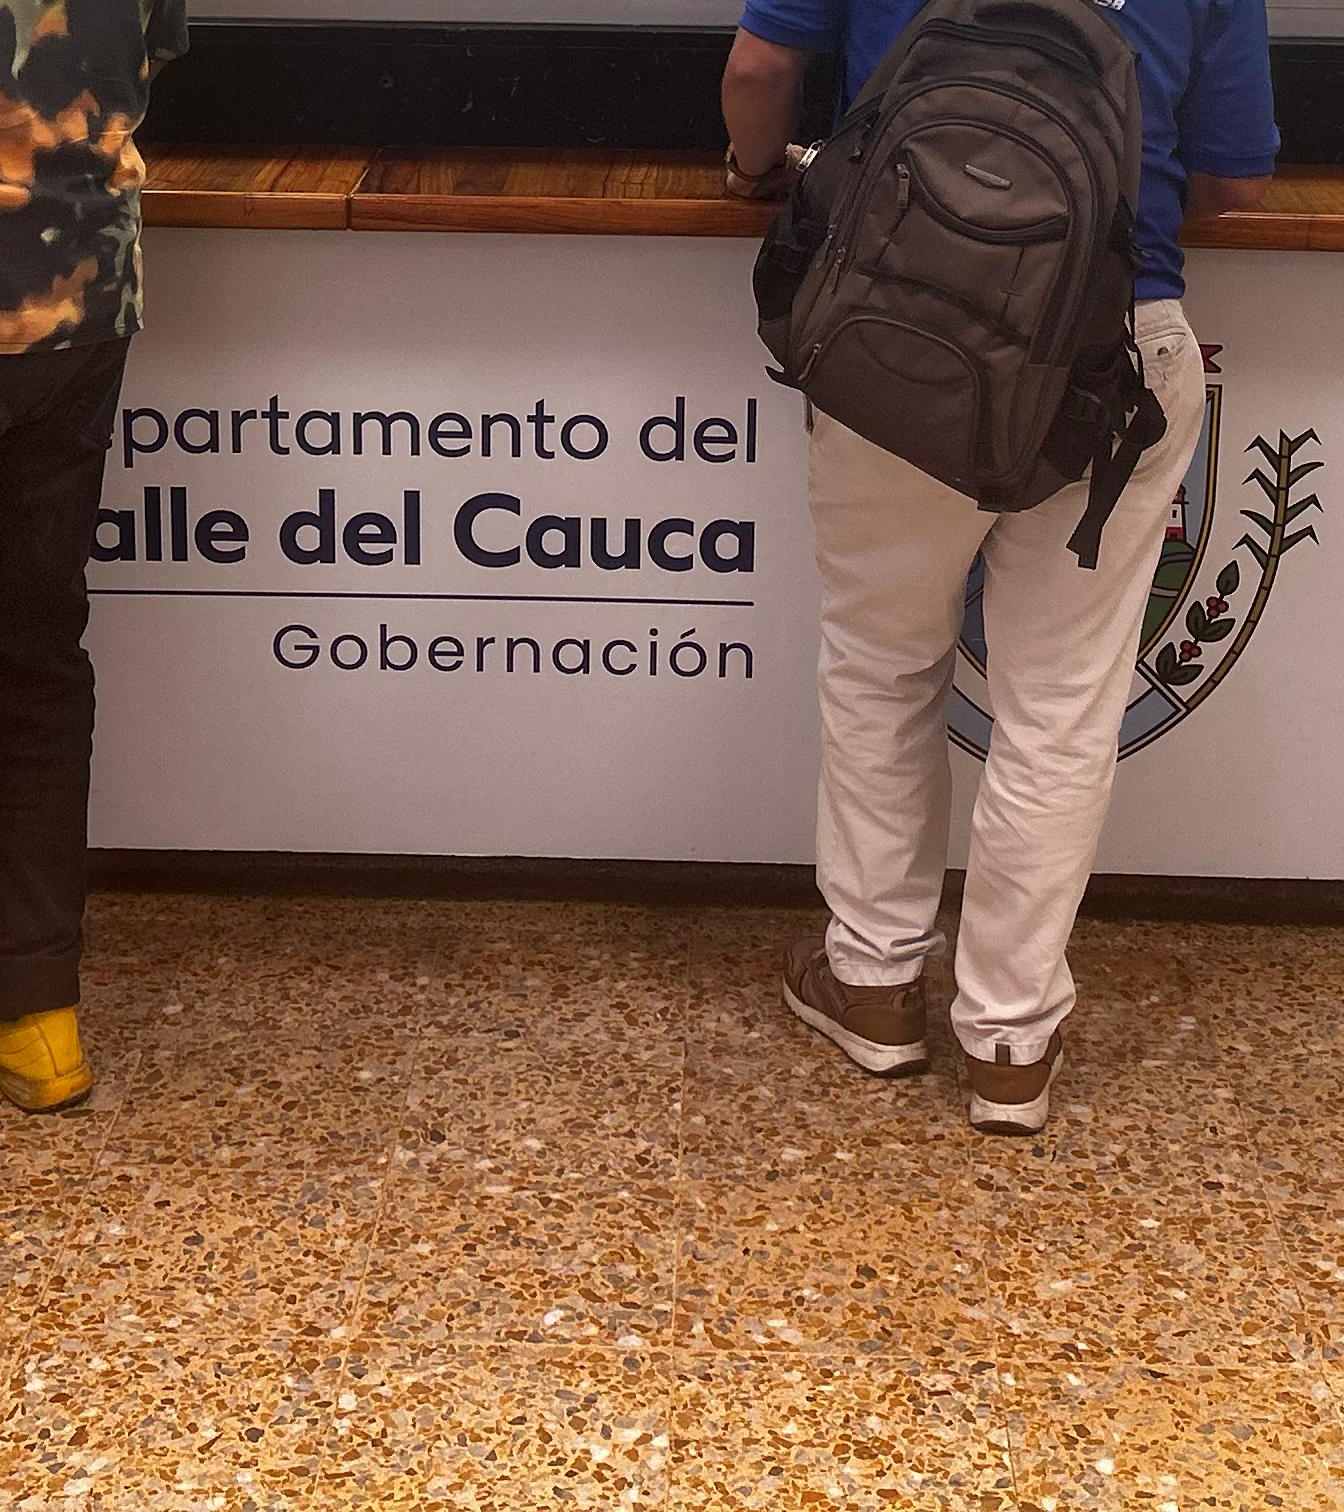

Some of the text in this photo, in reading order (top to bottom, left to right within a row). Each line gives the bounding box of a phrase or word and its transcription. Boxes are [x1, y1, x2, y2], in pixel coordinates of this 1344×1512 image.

[122, 395, 756, 468] partamento del
[89, 486, 755, 573] alle del Cauca
[272, 622, 753, 679] Gobernación
